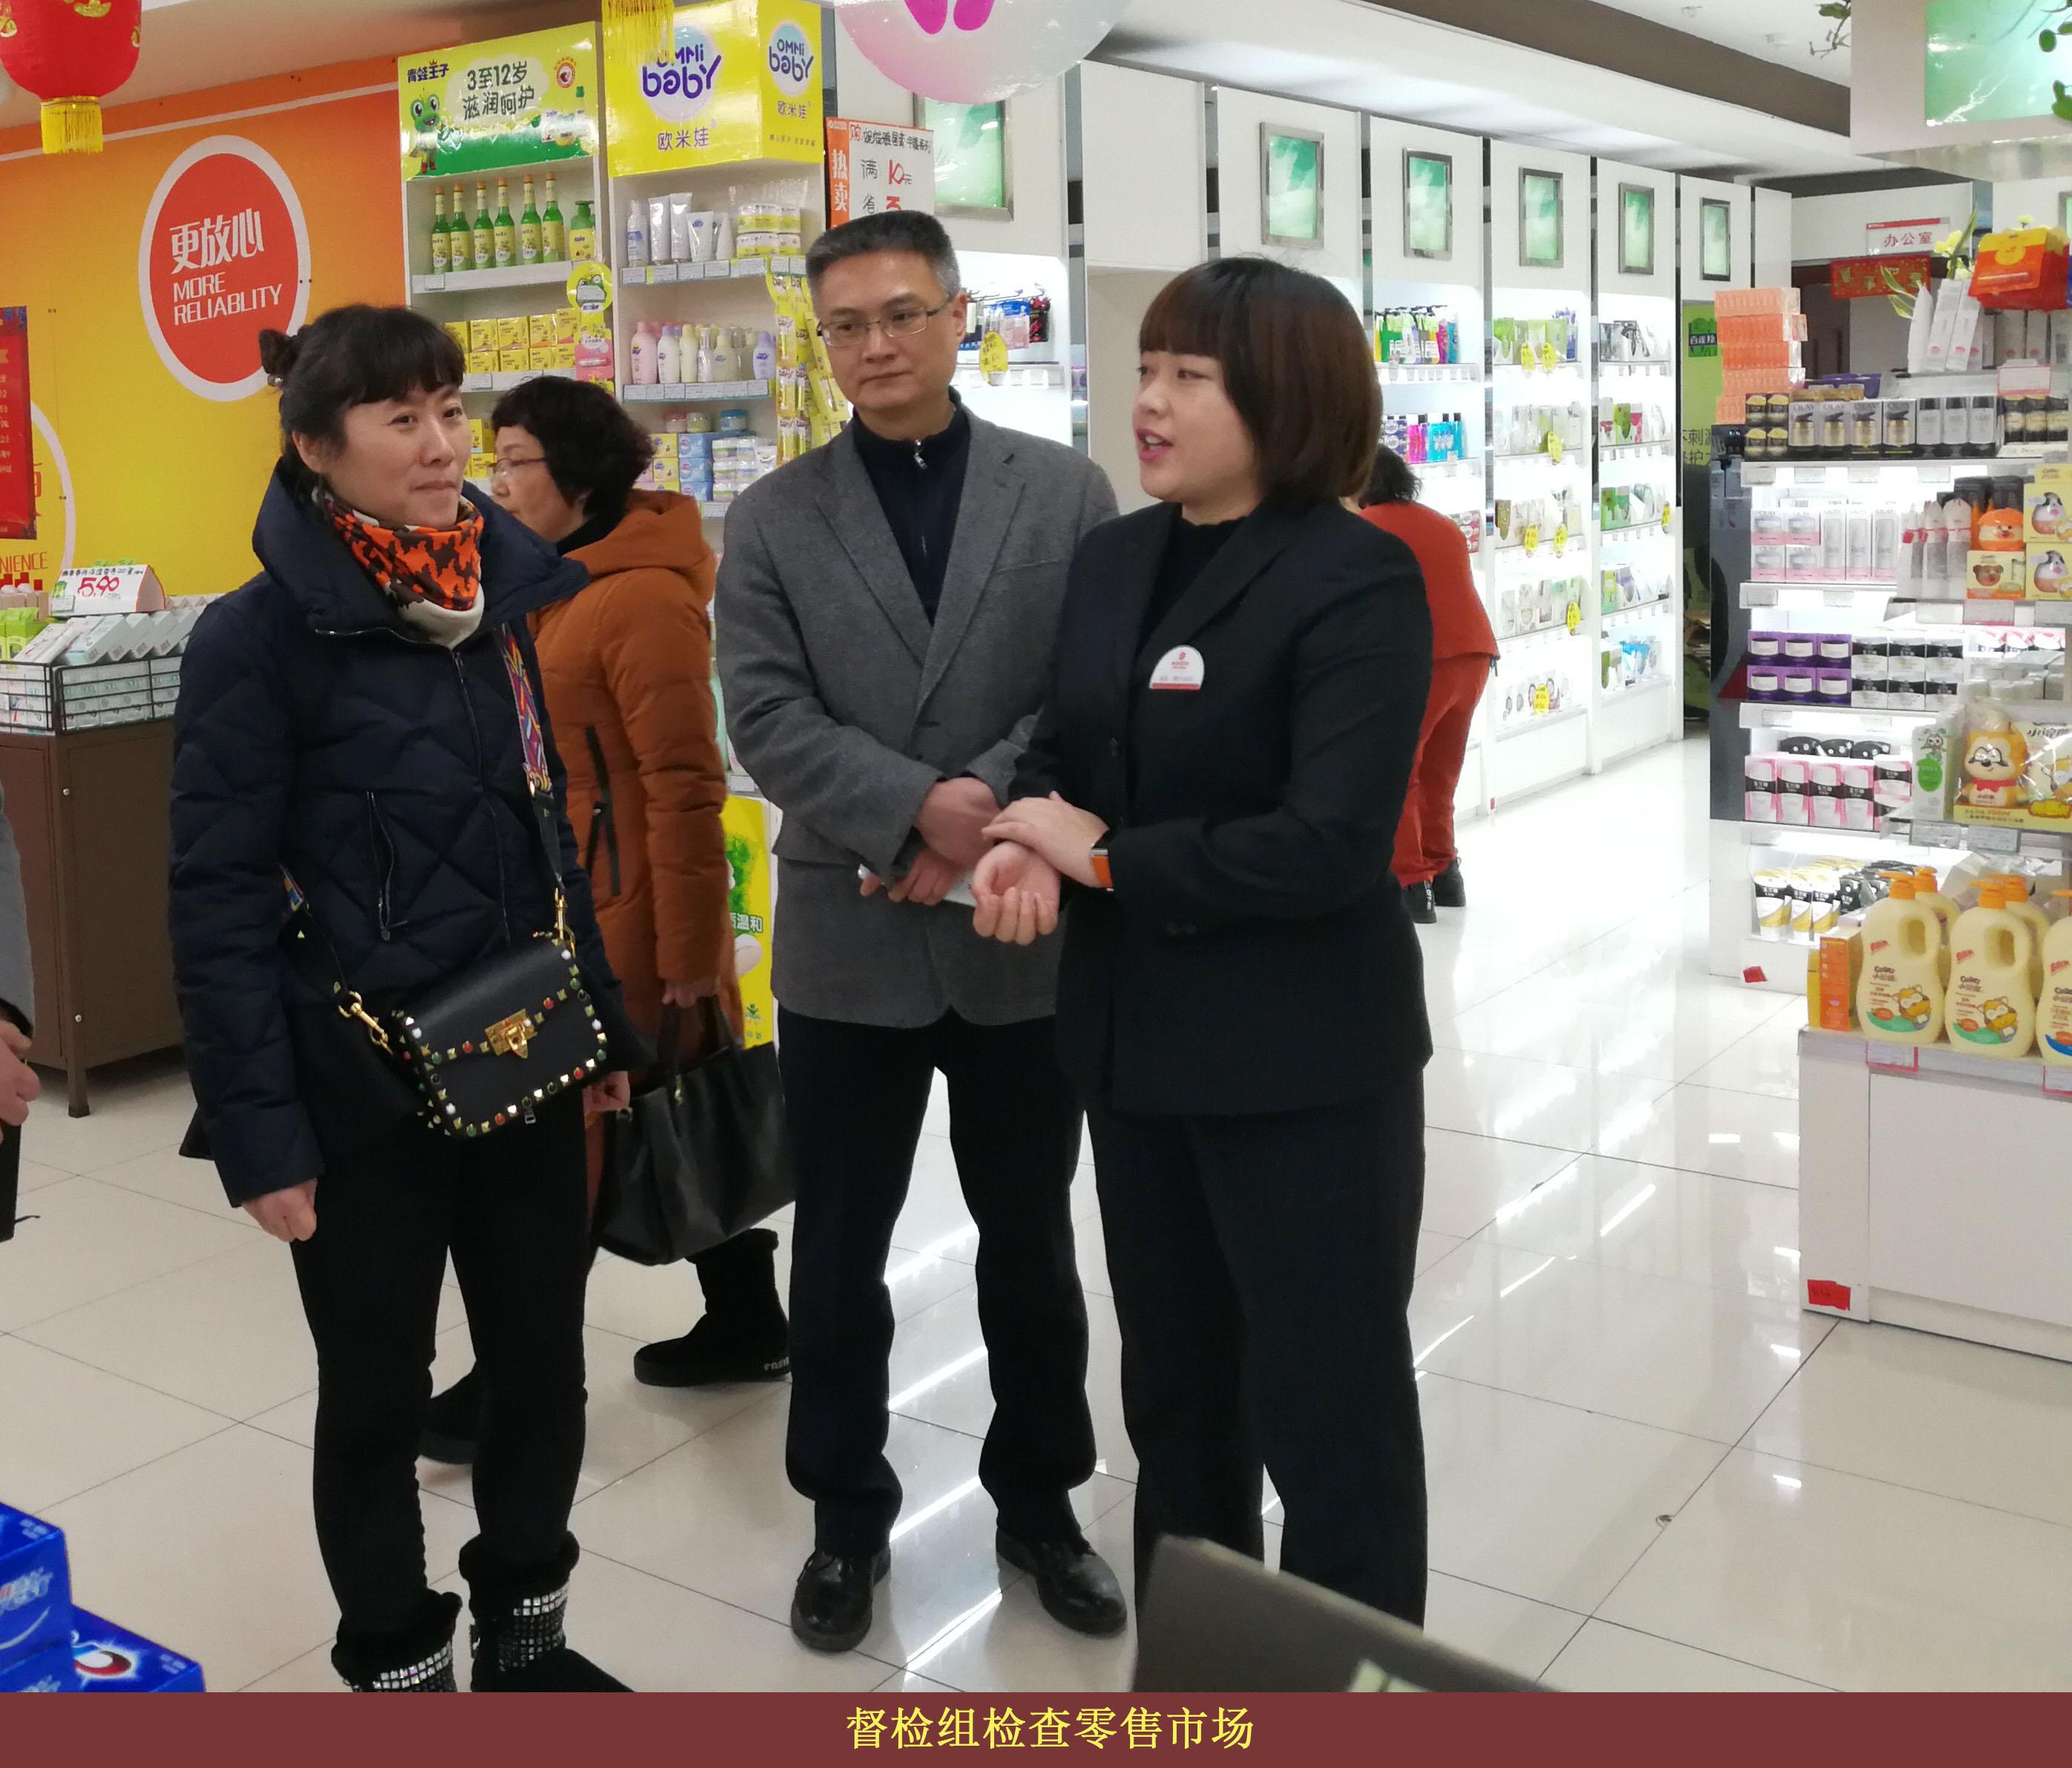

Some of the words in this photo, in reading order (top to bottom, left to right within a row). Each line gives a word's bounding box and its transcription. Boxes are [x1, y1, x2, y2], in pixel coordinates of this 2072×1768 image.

[408, 63, 450, 83] 青蛙王子
[467, 61, 528, 91] 3至12岁
[463, 85, 535, 121] 滋润呵护
[777, 100, 808, 120] 欧米娃
[658, 127, 709, 151] 欧米娃
[831, 149, 848, 212] 热卖
[861, 159, 878, 180] 满
[170, 209, 265, 274] 更放心
[1884, 231, 1934, 247] 办公室
[173, 272, 226, 300] MORE
[173, 284, 283, 326] RELIABLITY
